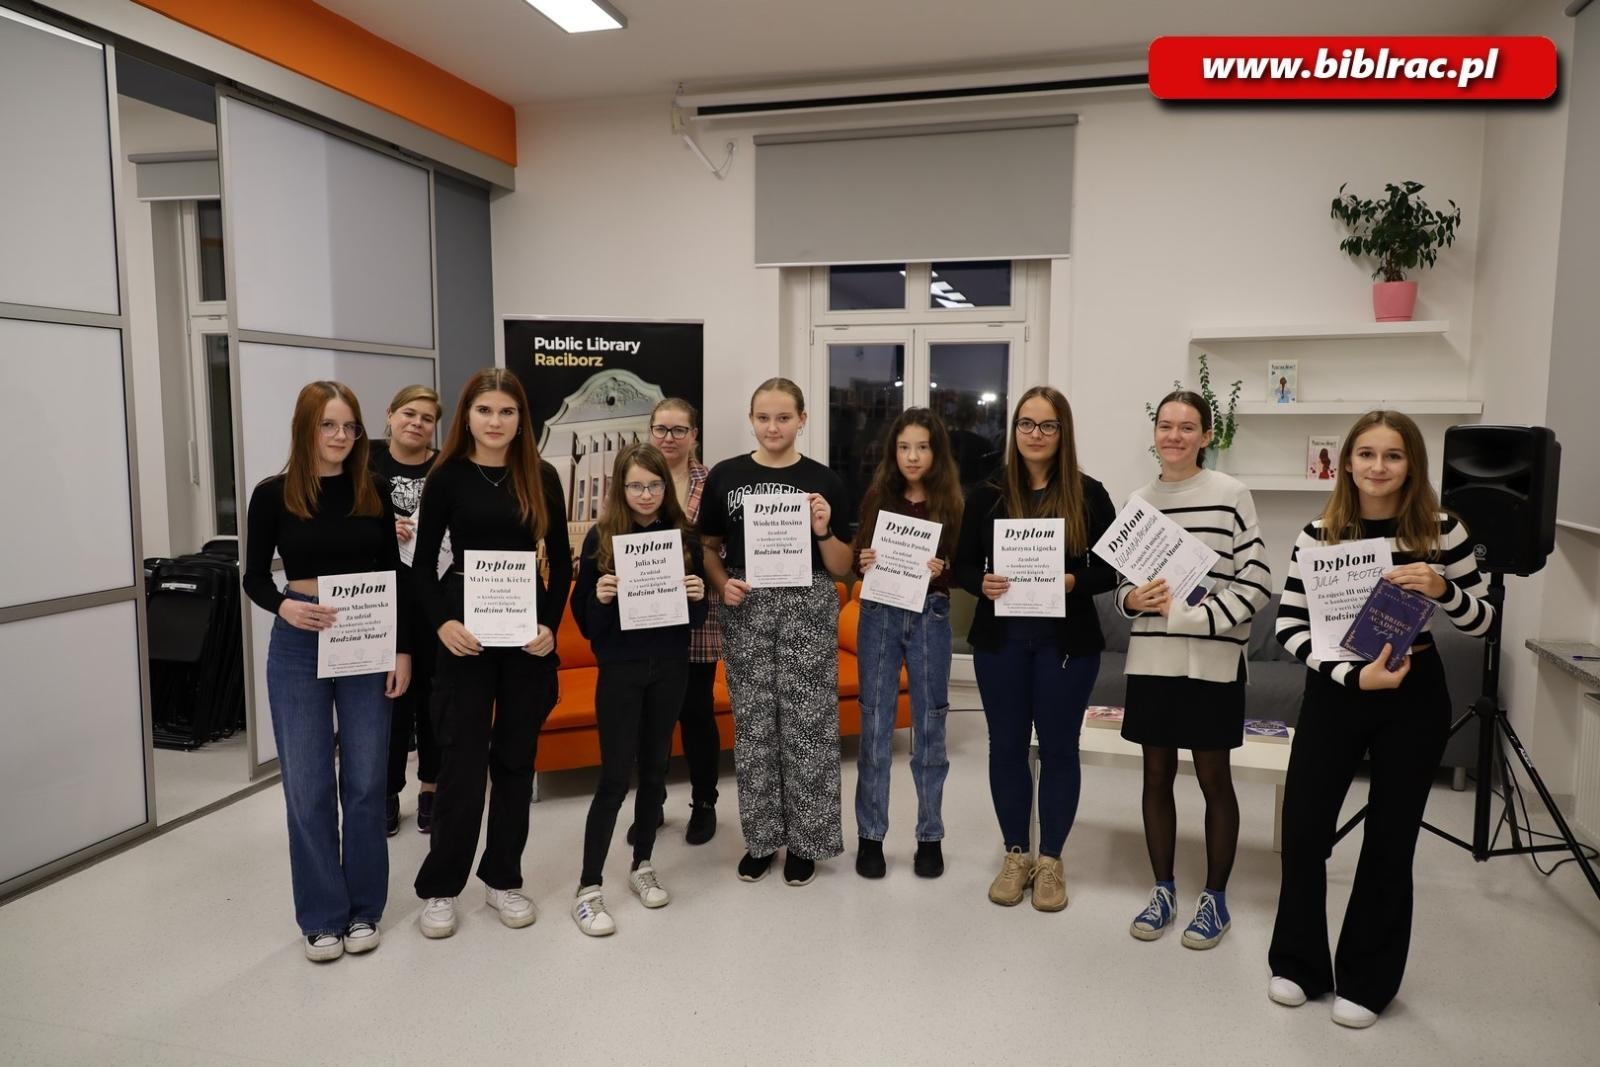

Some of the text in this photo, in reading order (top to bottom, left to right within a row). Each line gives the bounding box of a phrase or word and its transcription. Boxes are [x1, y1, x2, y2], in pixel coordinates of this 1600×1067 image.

[534, 336, 640, 354] Public Library
[534, 352, 603, 367] Raciborz
[754, 503, 802, 515] Dyplom
[886, 522, 931, 539] Dyplom
[1004, 528, 1055, 540] Dyplom
[1108, 510, 1144, 553] Dyplom
[625, 541, 673, 555] Dyplom
[475, 560, 526, 572] Dyplom
[634, 560, 650, 568] Julia
[1146, 556, 1168, 582] Rodzina
[1166, 537, 1184, 558] Monet
[1313, 554, 1376, 572] Dyplom
[875, 564, 922, 579] Rodzina Monet
[332, 583, 386, 598] Dyplom
[1312, 576, 1340, 591] JULIA
[351, 601, 389, 611] Machowska
[1369, 606, 1412, 632] DUNBRIDGE
[1370, 616, 1404, 636] ACADEMY
[364, 632, 387, 640] Monet
